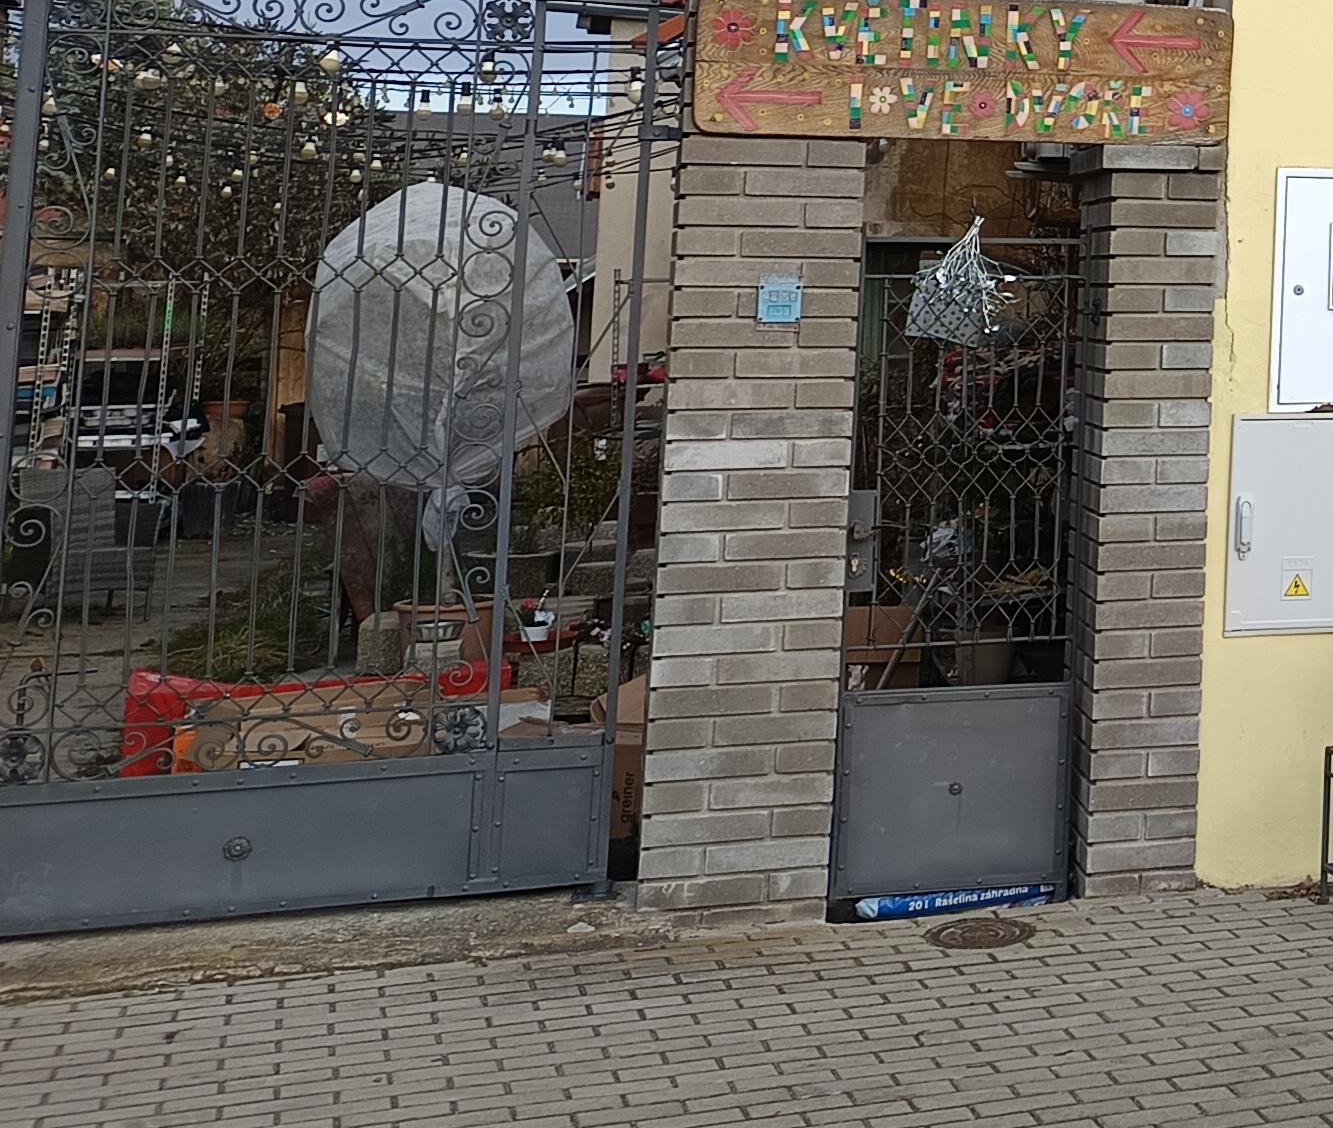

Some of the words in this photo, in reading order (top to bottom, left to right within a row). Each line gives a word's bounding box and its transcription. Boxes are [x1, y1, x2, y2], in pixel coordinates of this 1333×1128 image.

[900, 76, 971, 135] VE
[620, 770, 635, 824] greiner
[908, 900, 921, 911] 20
